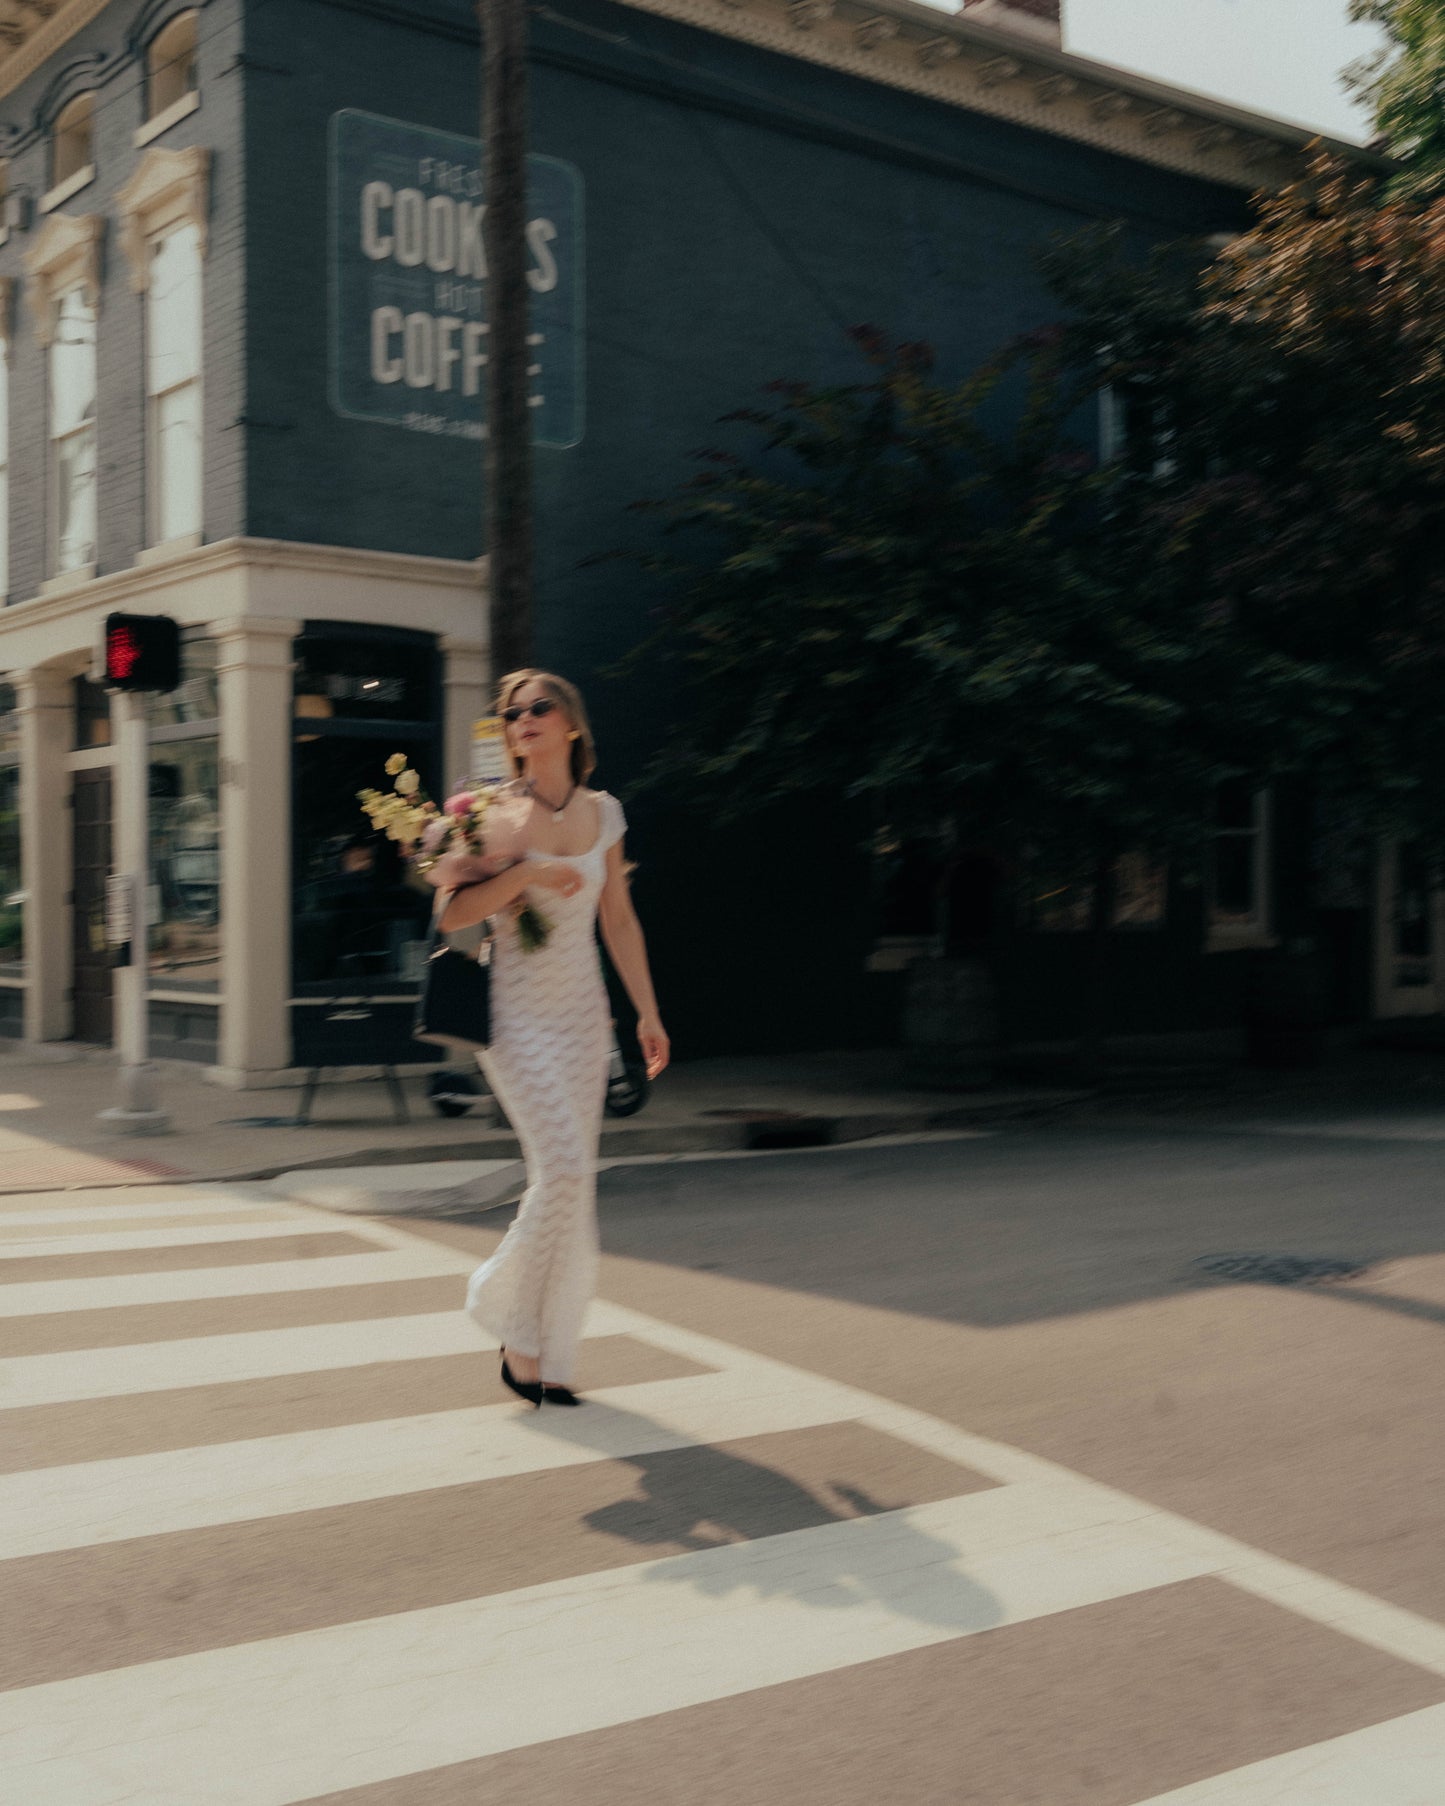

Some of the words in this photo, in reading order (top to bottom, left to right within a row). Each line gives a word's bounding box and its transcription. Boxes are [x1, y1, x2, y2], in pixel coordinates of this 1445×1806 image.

[419, 157, 484, 197] FRES
[361, 181, 558, 292] COOKS
[371, 305, 546, 407] COFF
